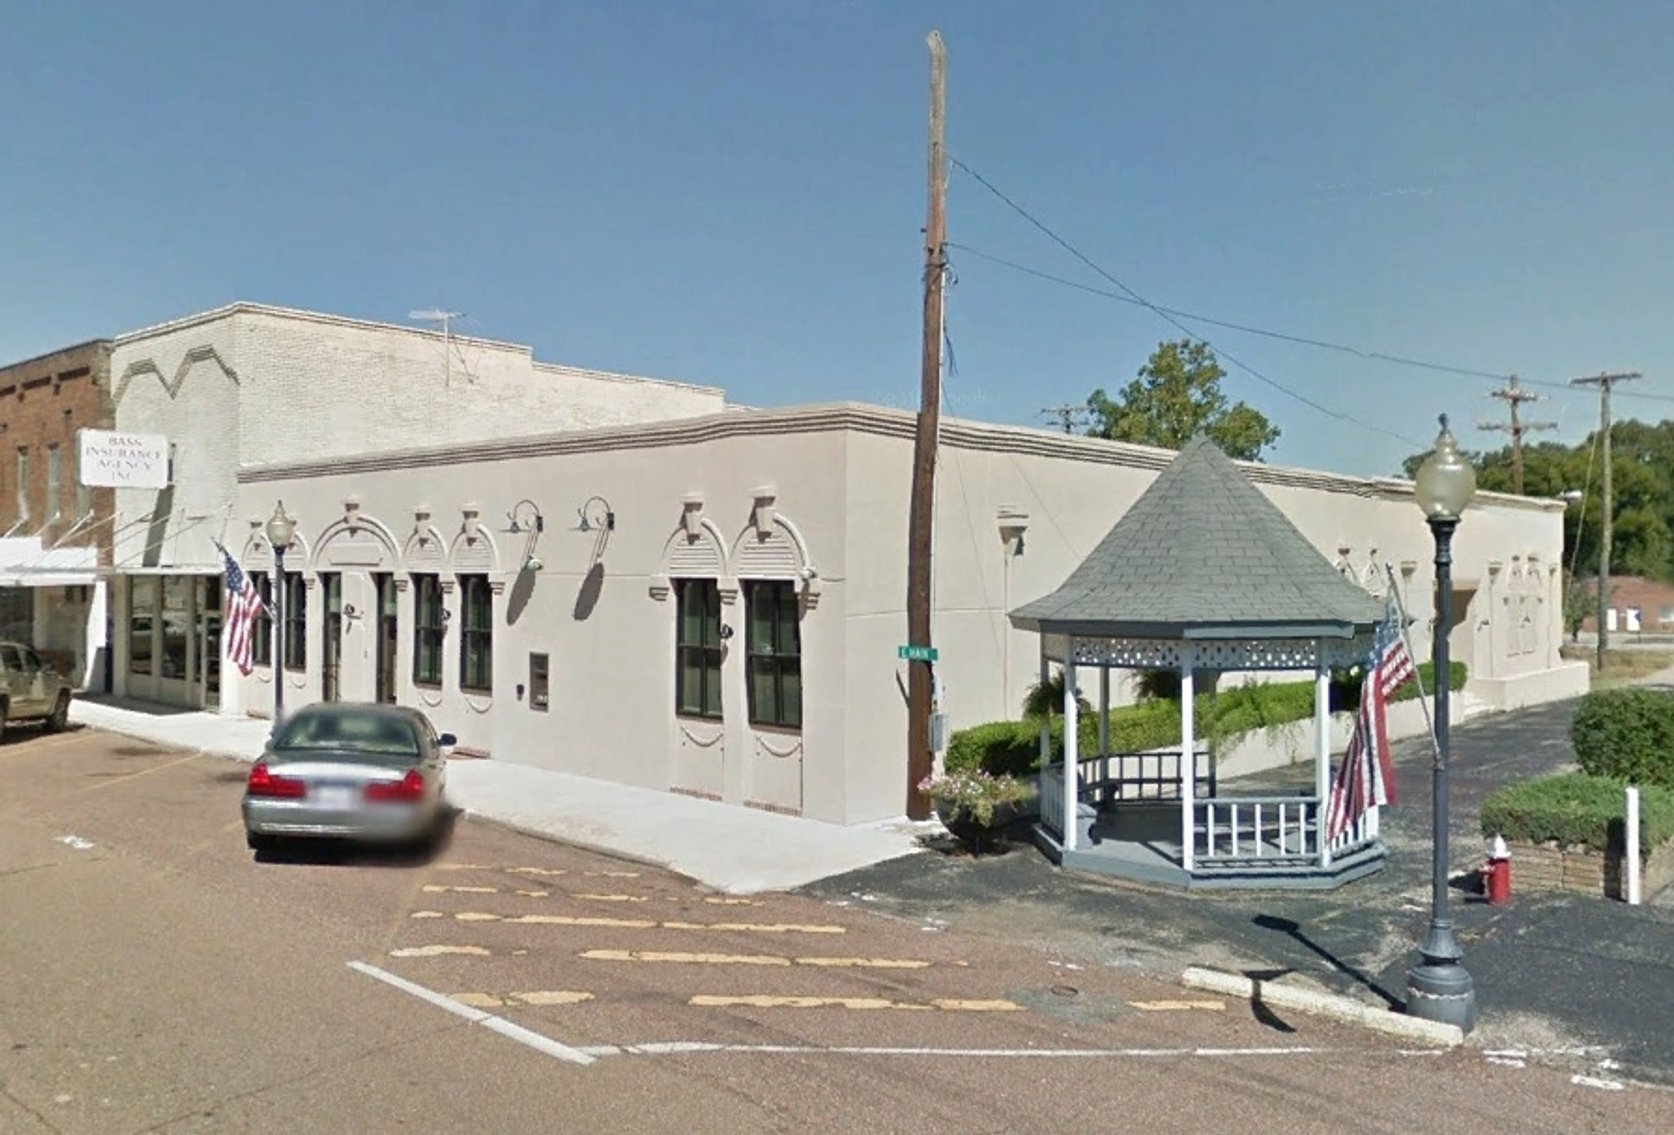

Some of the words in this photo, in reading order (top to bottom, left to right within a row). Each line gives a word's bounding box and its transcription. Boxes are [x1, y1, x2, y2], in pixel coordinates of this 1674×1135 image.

[109, 437, 142, 446] BASS
[86, 446, 160, 459] INSURANCE
[99, 460, 151, 470] AGENCY
